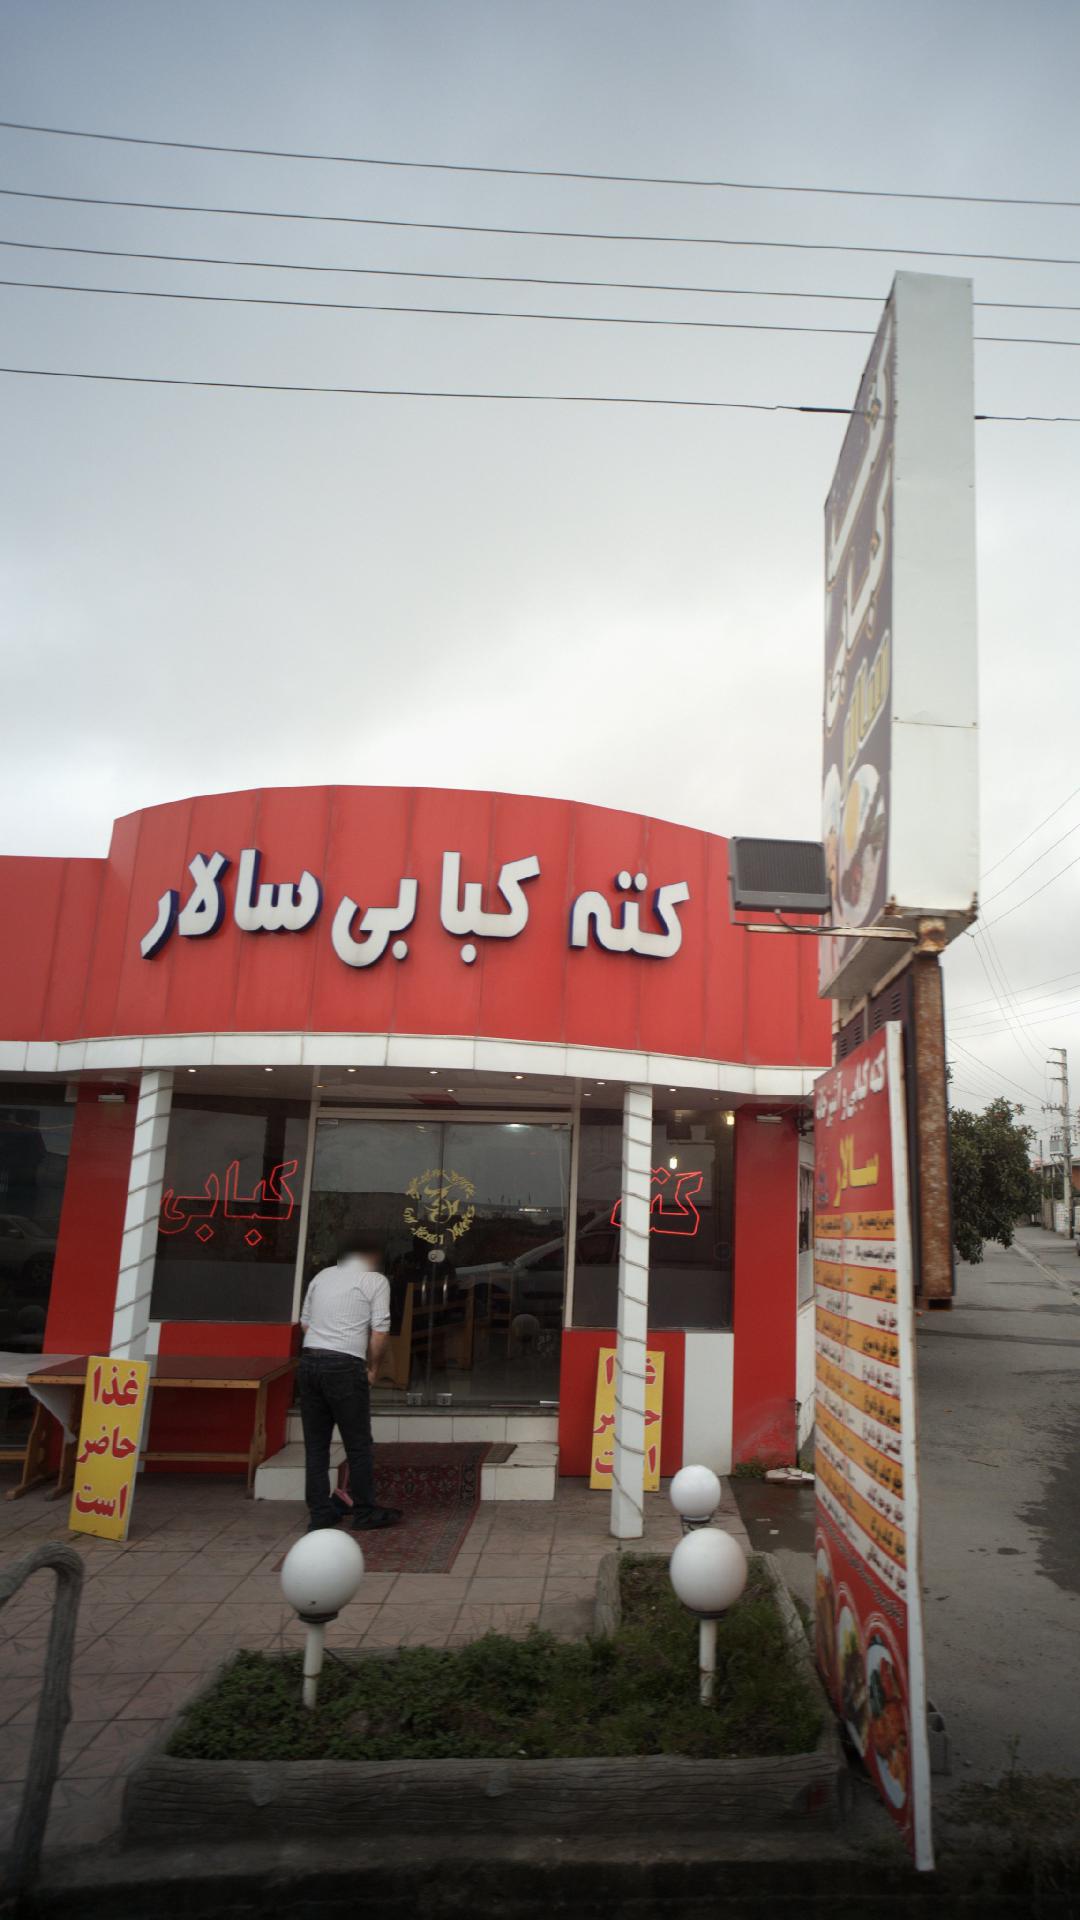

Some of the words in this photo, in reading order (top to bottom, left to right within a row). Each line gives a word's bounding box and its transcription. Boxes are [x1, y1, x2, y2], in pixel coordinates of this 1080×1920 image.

[140, 849, 322, 960] سالار
[331, 851, 541, 967] کبابی
[569, 870, 690, 958] کته
[158, 1160, 298, 1246] کبابی
[93, 1365, 139, 1407] غذا
[76, 1425, 136, 1464] حاضر
[75, 1485, 128, 1519] است
